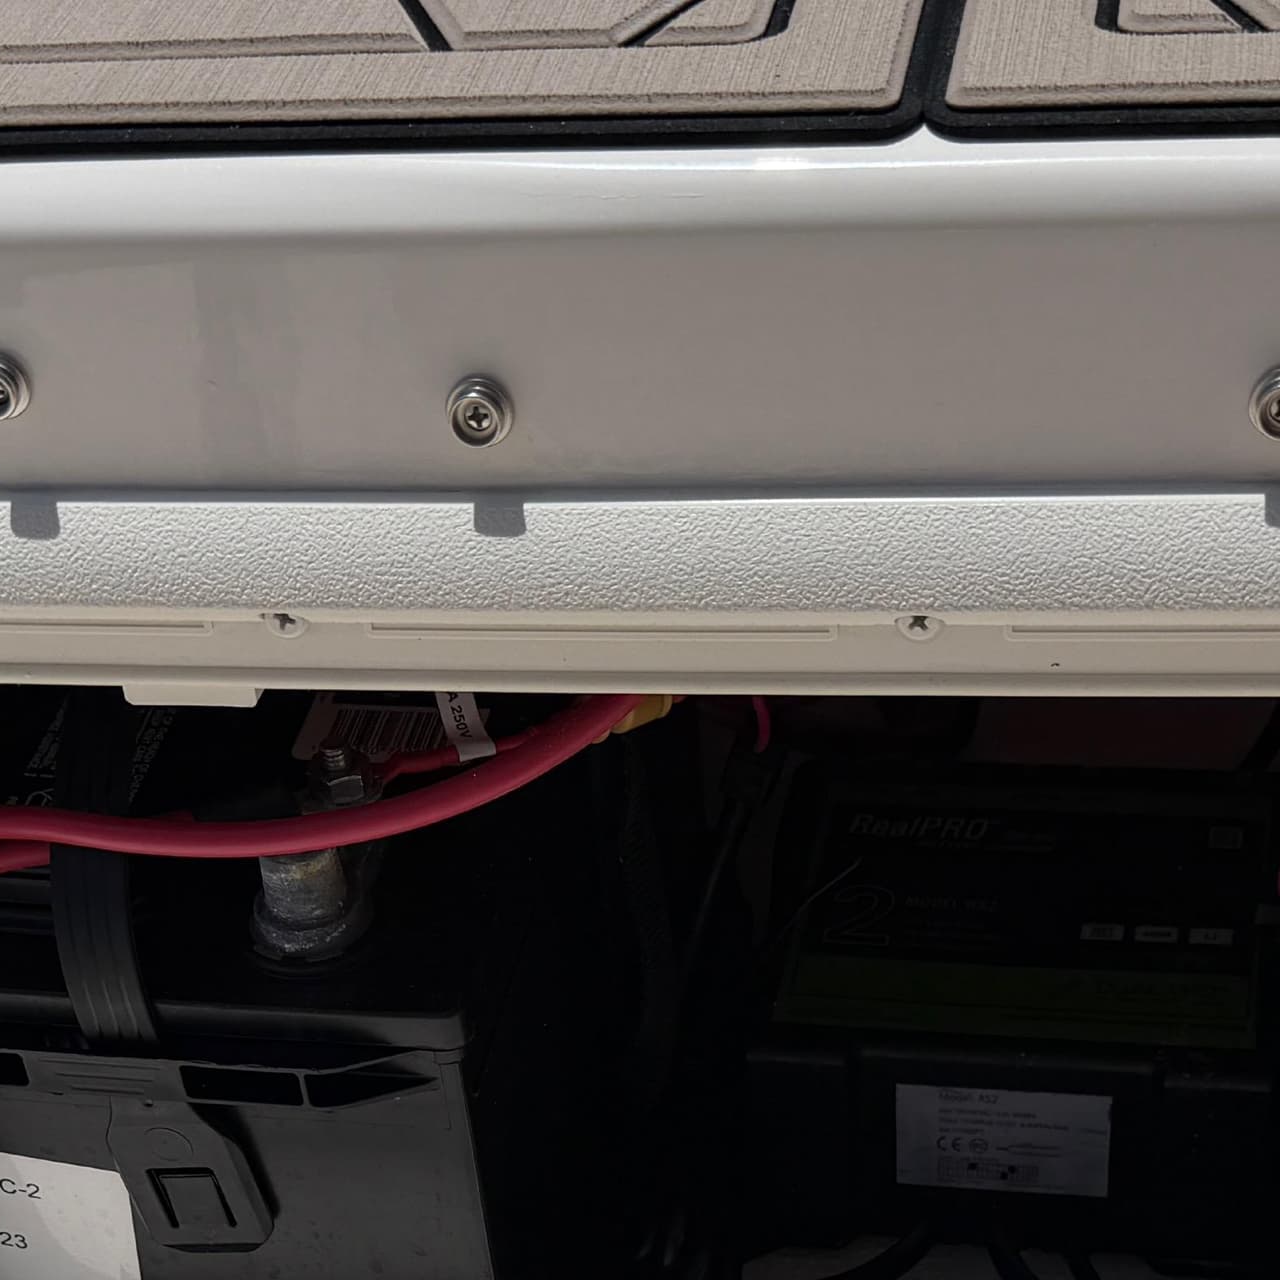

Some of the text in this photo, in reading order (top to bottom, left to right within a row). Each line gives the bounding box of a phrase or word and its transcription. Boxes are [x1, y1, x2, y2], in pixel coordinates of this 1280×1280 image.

[450, 705, 473, 739] 250V
[847, 812, 990, 841] RealPRO
[821, 883, 897, 947] 2
